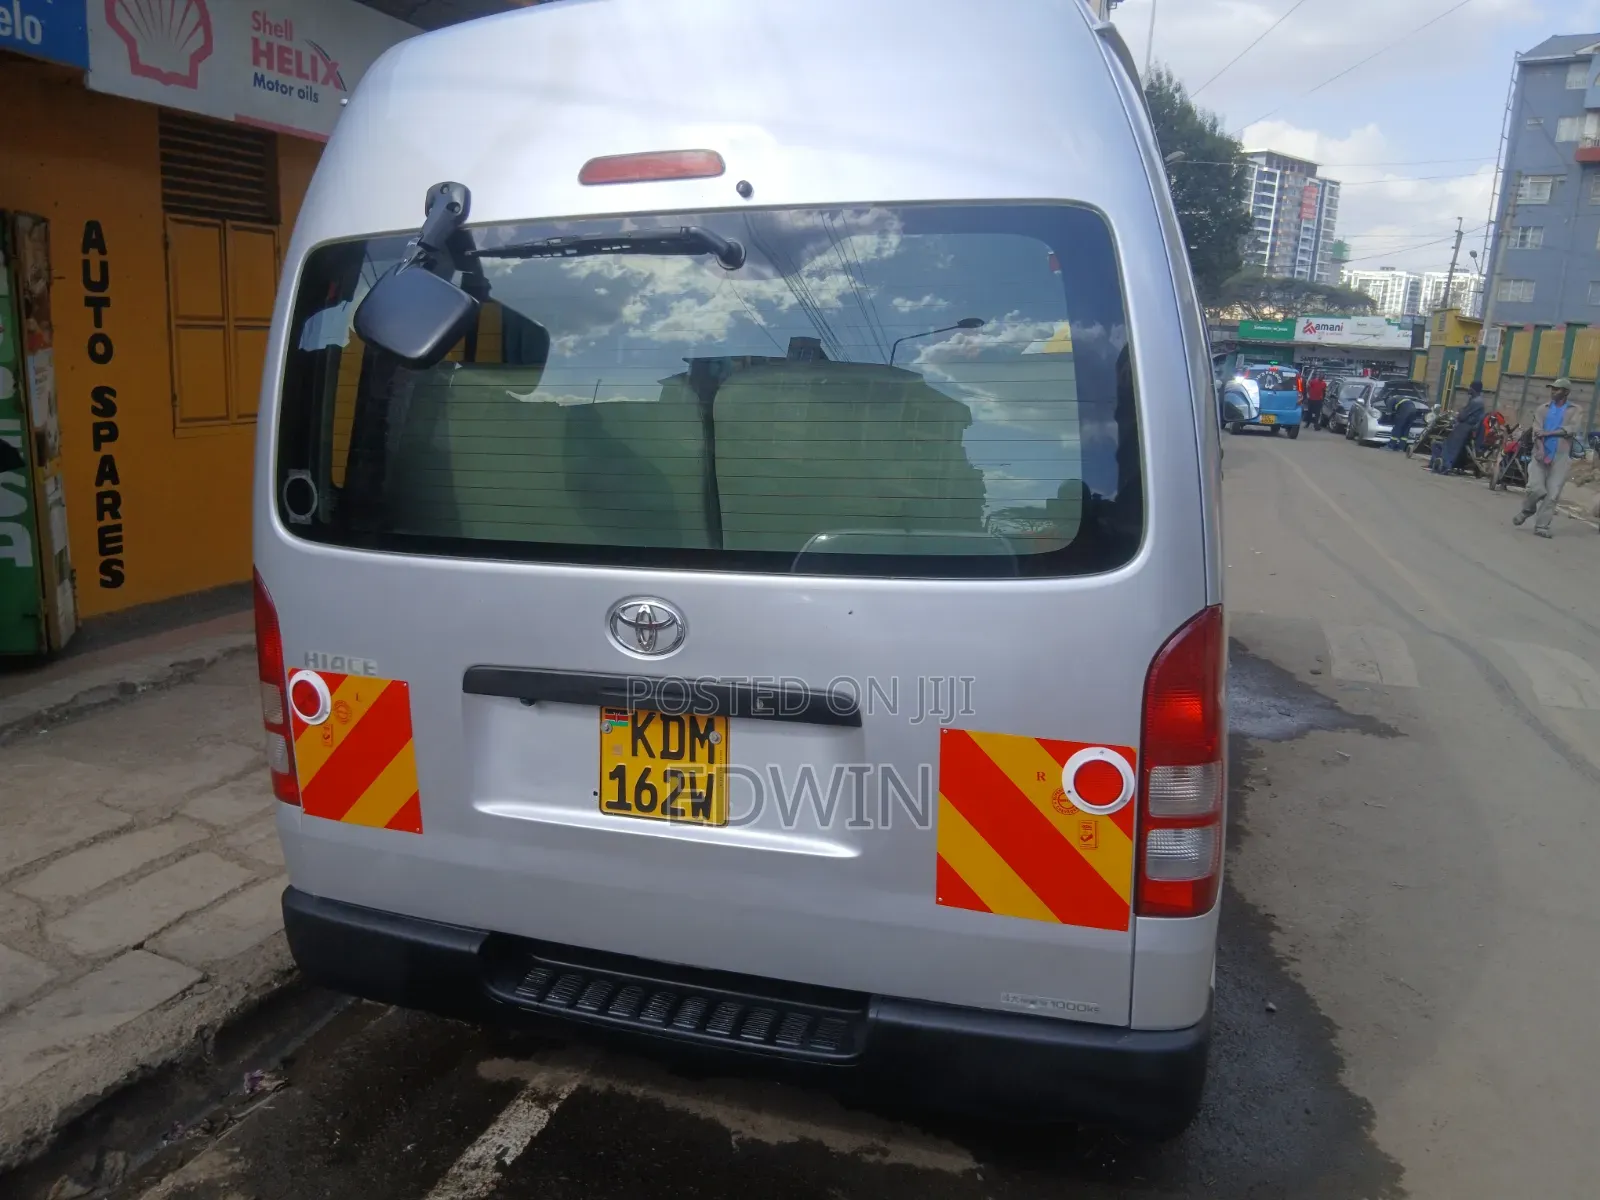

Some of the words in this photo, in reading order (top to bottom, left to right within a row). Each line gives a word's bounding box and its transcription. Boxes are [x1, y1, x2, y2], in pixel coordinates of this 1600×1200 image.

[251, 10, 293, 42] Shell
[251, 36, 347, 91] HELIX
[252, 72, 294, 98] Motor
[297, 85, 320, 104] oils
[81, 219, 114, 365] AUTO
[90, 385, 125, 589] SPARES
[304, 651, 377, 676] HIACE
[631, 710, 716, 765] KDM
[605, 763, 715, 821] 162W
[1036, 771, 1046, 782] R
